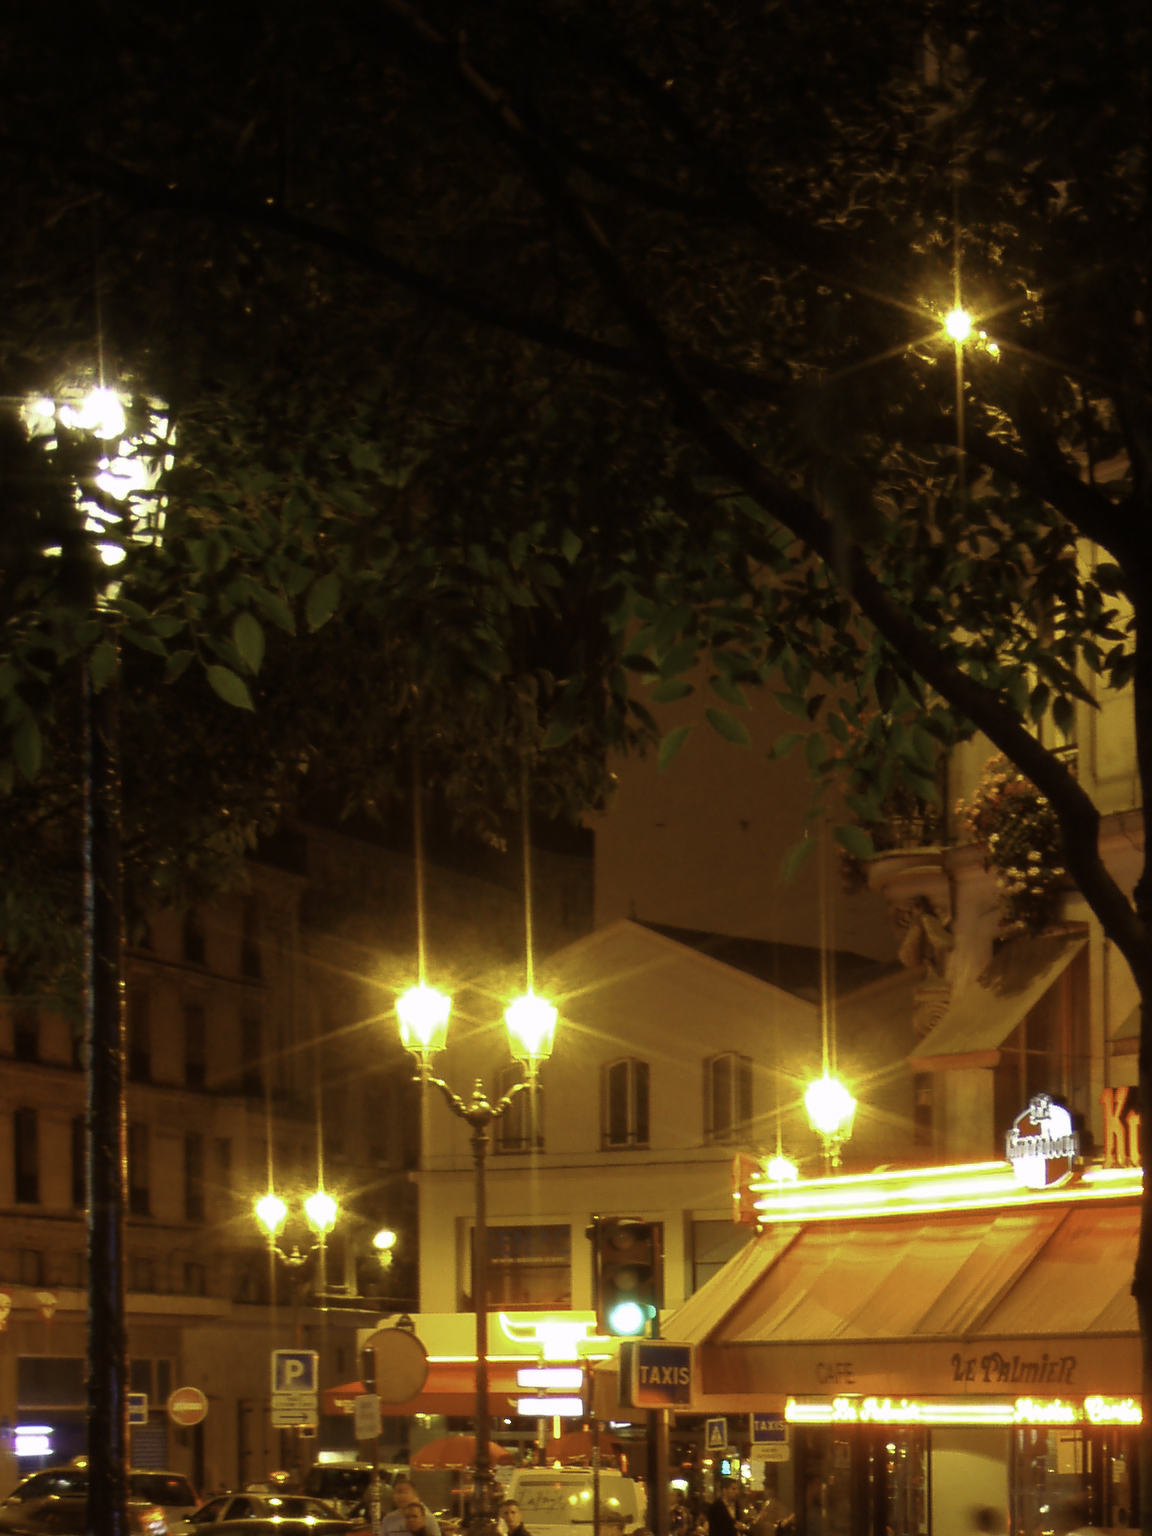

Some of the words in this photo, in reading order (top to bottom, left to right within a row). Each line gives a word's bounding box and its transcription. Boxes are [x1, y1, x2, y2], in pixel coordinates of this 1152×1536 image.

[285, 1359, 305, 1385] P
[639, 1365, 690, 1385] TAXIS
[754, 1420, 785, 1432] TAXIS
